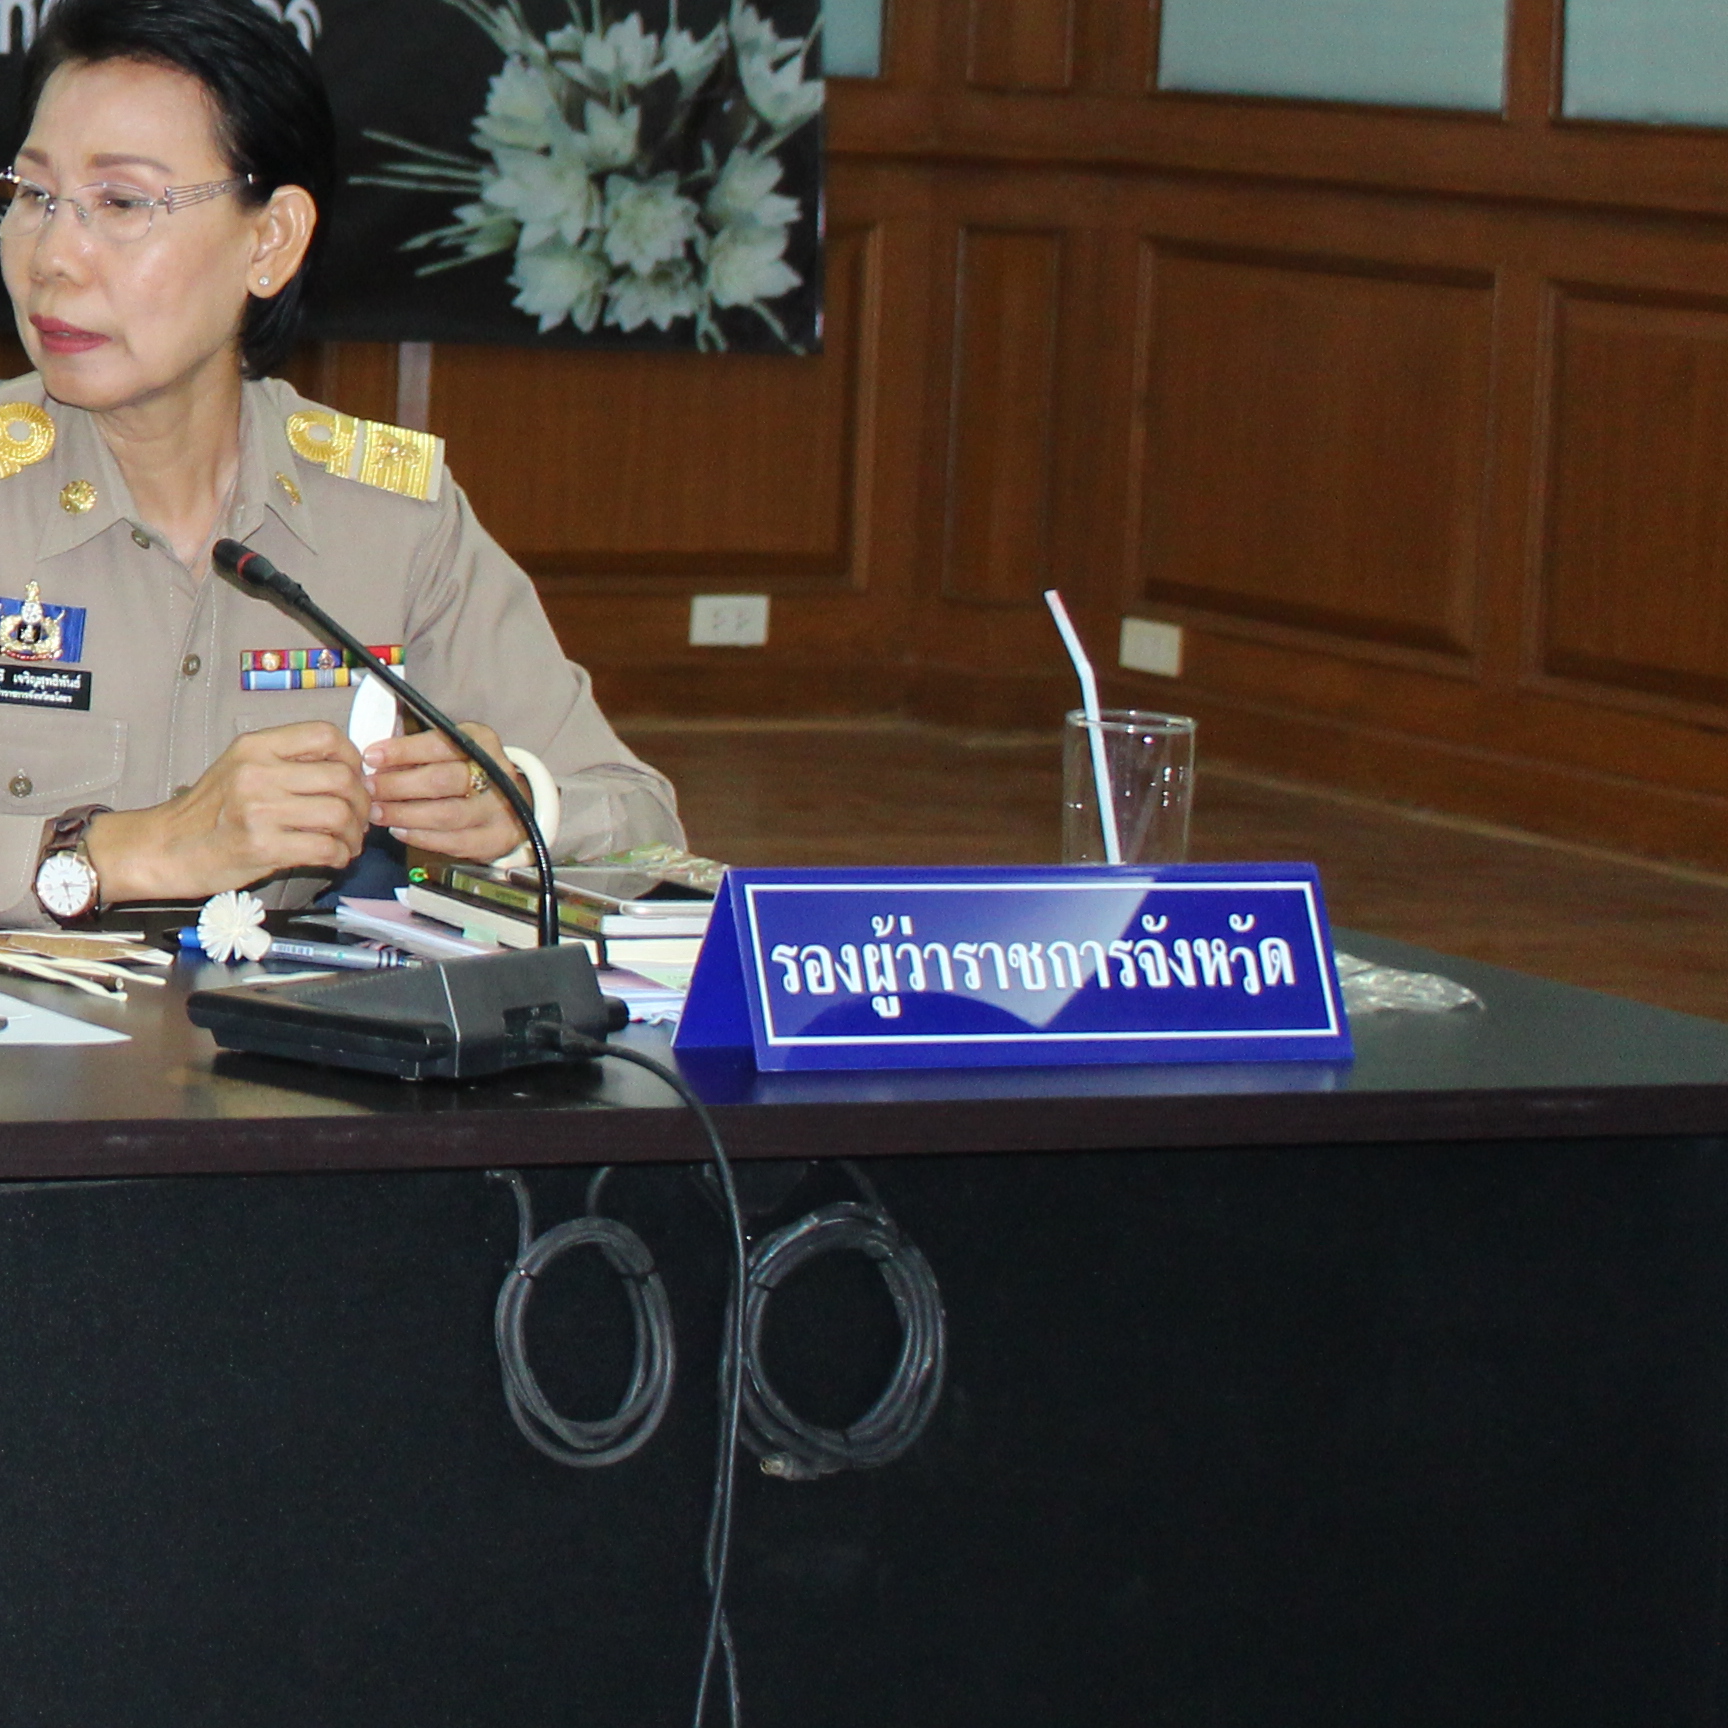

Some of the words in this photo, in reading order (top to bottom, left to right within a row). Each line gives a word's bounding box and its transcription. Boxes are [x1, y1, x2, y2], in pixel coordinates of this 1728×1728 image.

[770, 914, 1295, 1019] รองผู้ว่าราชการจังหวัด
